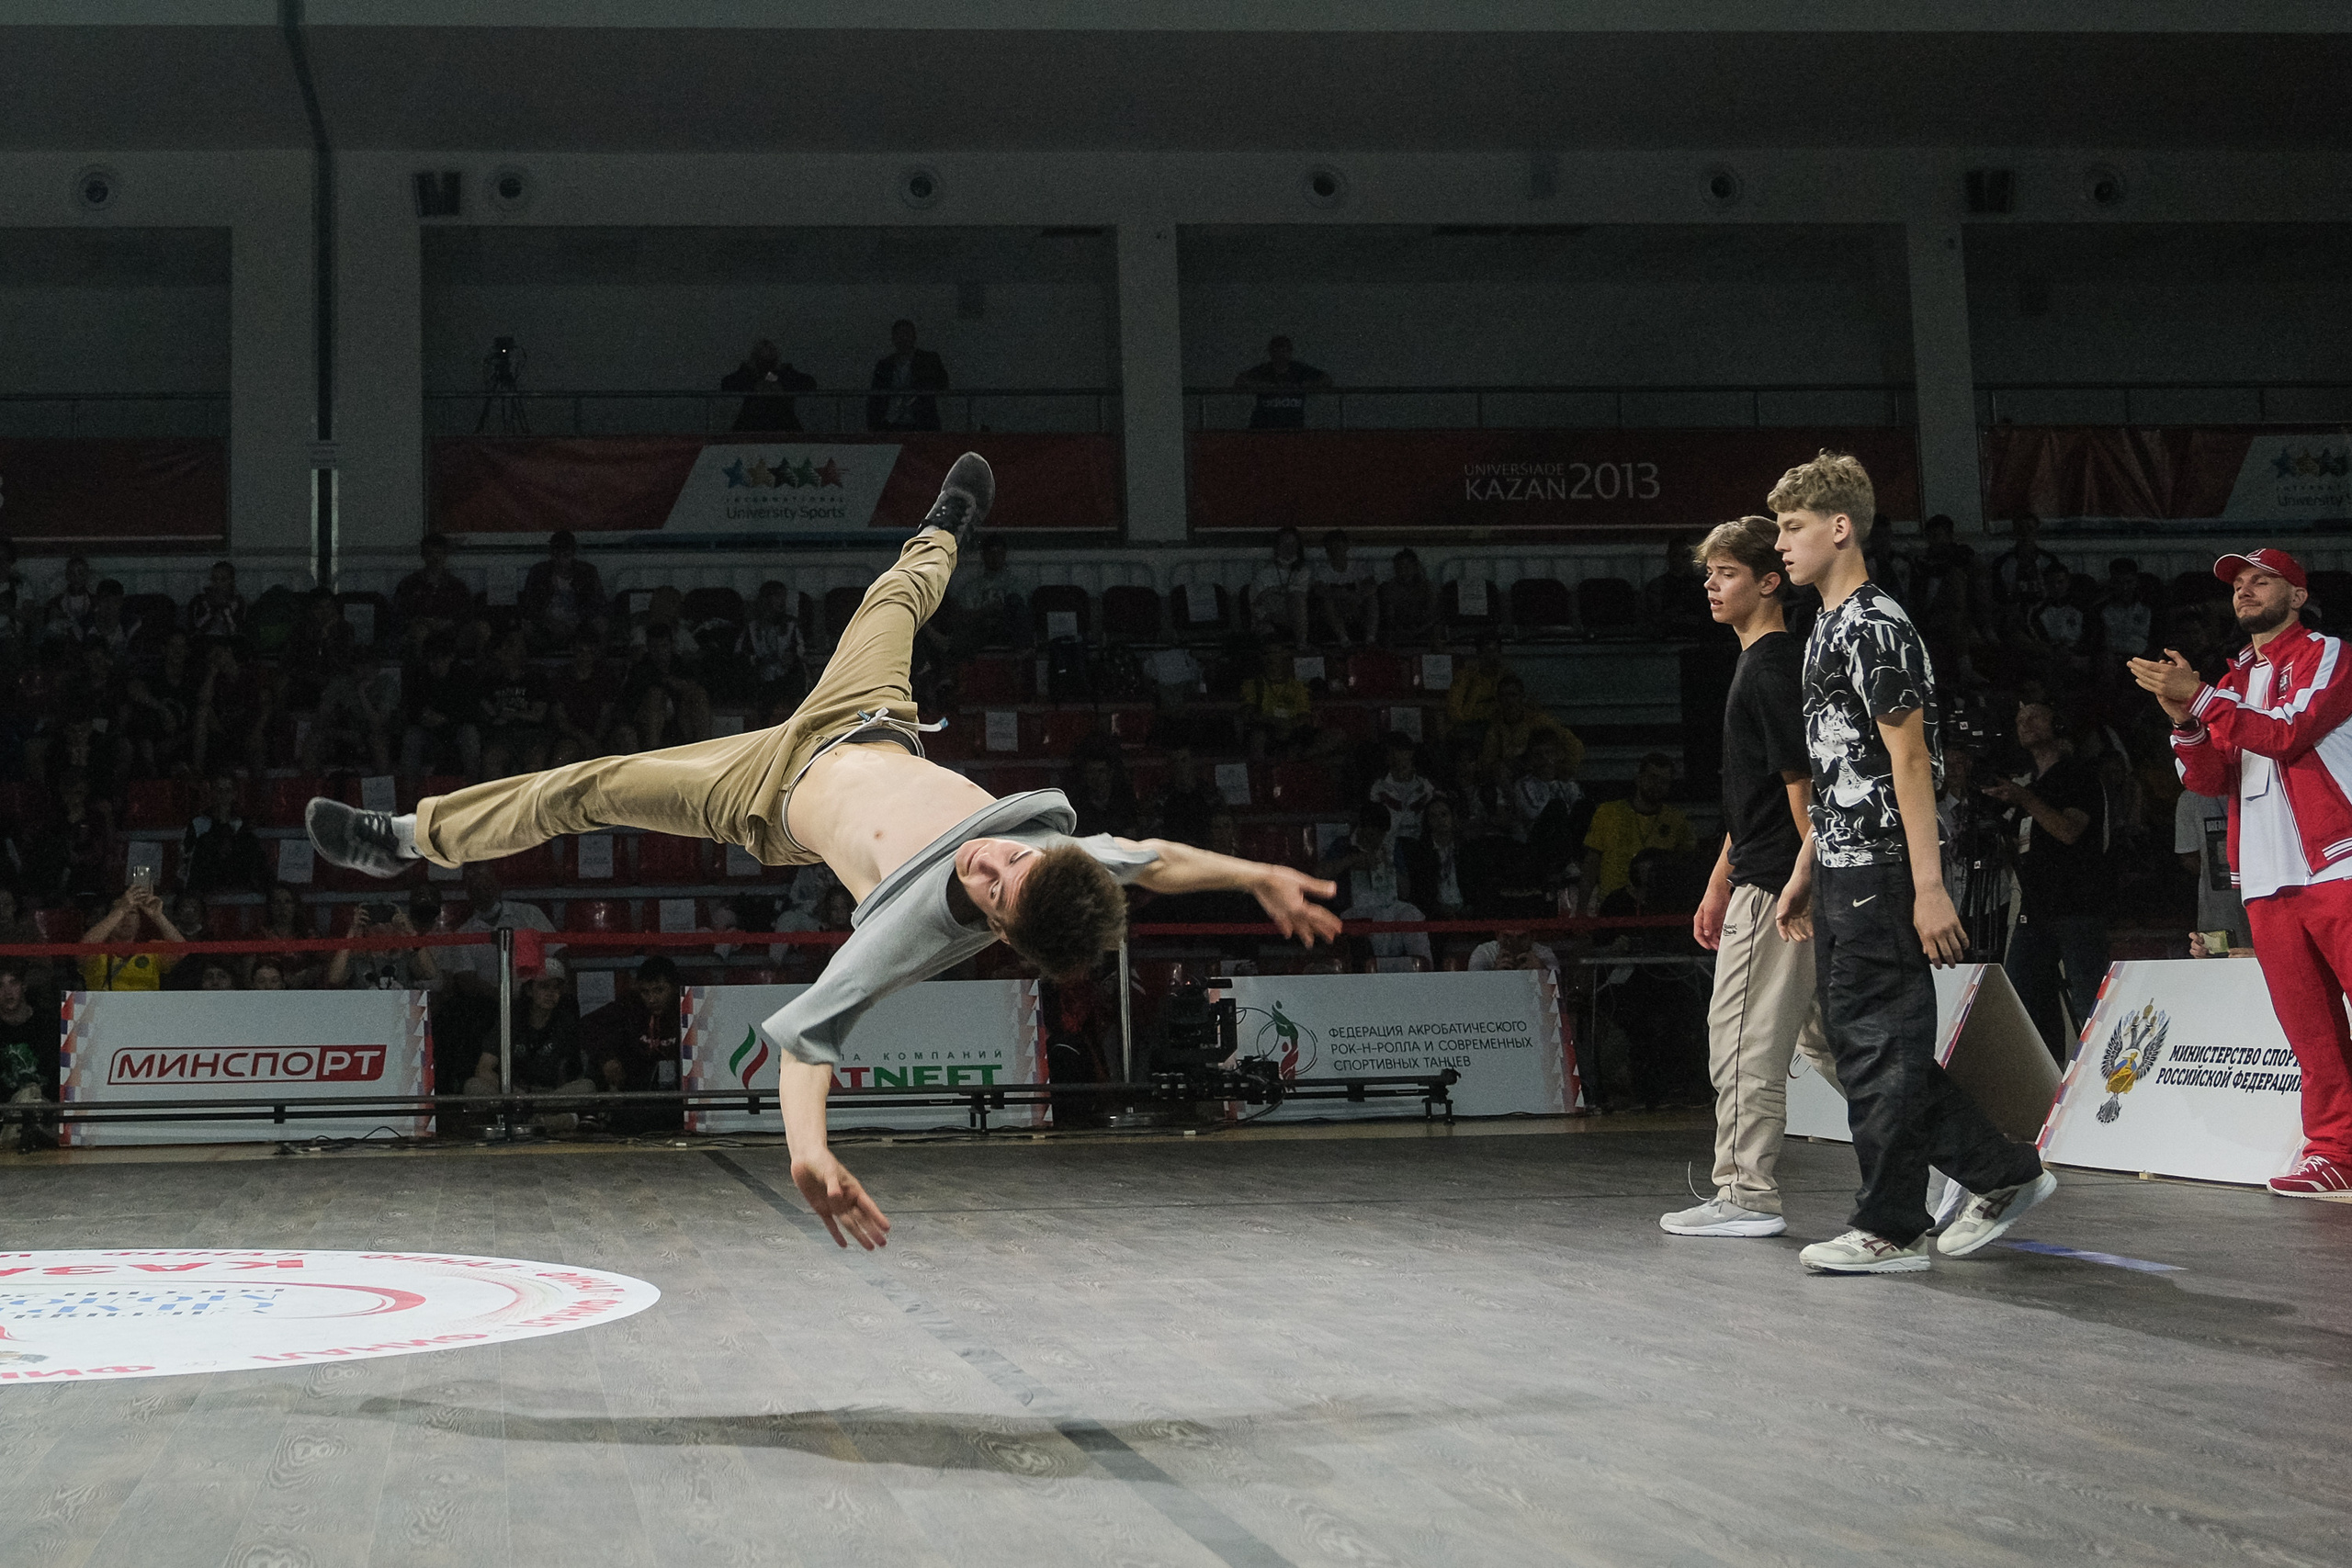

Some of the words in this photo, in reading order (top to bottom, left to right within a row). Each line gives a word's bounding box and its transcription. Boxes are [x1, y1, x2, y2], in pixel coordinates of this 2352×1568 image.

[1464, 463, 1564, 477] UNIVERSIADE
[727, 505, 797, 520] University
[800, 505, 845, 520] Sports
[1329, 1024, 1404, 1039] ФЕДЕРАЦИЯ
[1408, 1021, 1527, 1036] АКРОБАТИЧЕСКОГО
[1424, 1041, 1434, 1052] И
[1438, 1037, 1533, 1051] СОВРЕМЕННЫХ
[118, 1050, 381, 1078] МИНСПОРТ
[883, 1049, 1002, 1061] КОМПАНИЙ
[1333, 1057, 1420, 1071] СПОРТИВНЫХ
[1423, 1055, 1472, 1068] ТАНЦЕВ
[2168, 1044, 2262, 1066] МИНИСТЕРСТВО
[778, 1065, 1002, 1088] TNEFT
[2155, 1064, 2233, 1089] РОССИЙСКОЙ
[250, 1333, 490, 1361] ФИНАЛ
